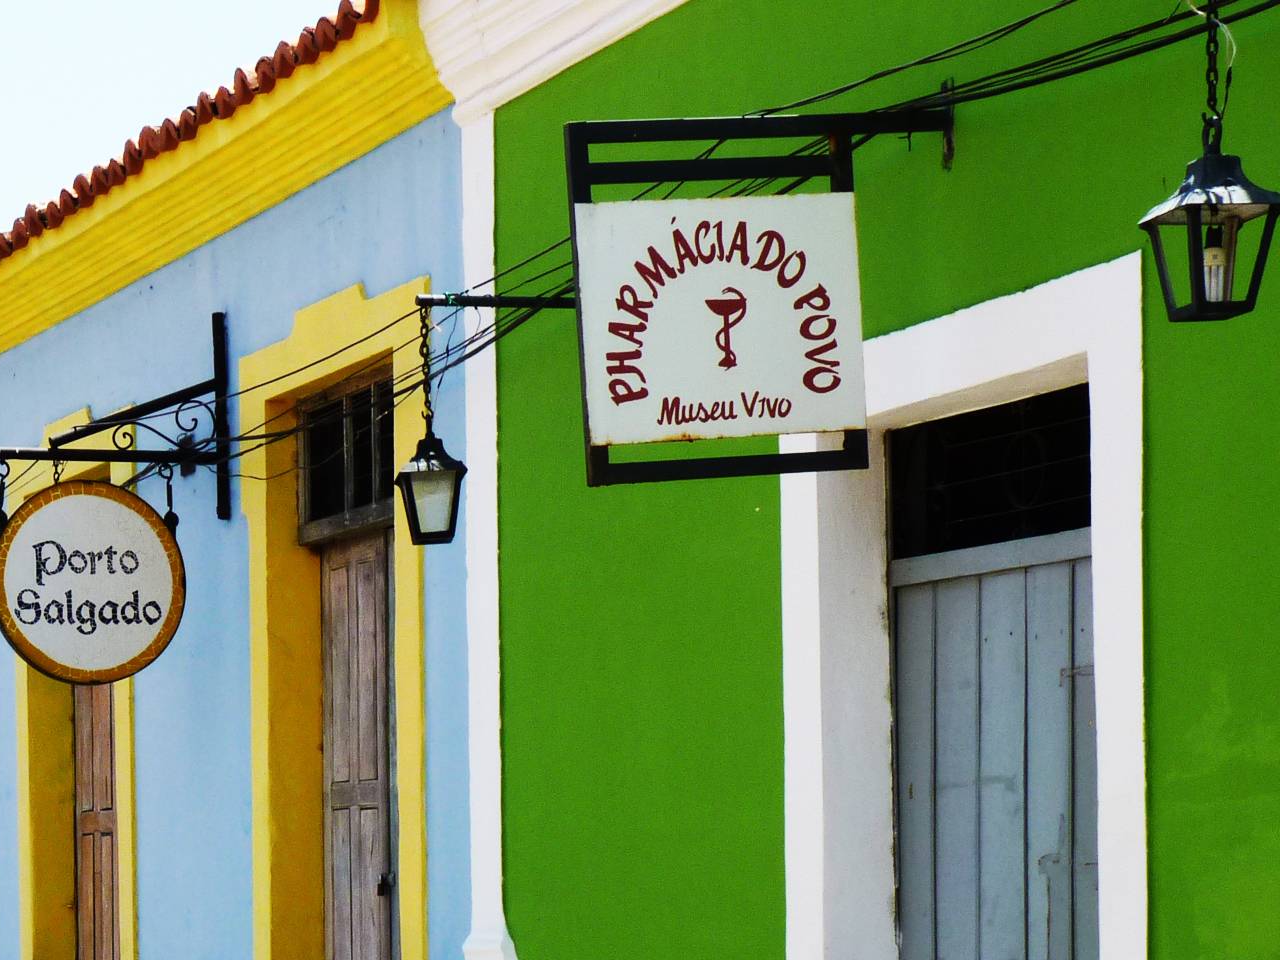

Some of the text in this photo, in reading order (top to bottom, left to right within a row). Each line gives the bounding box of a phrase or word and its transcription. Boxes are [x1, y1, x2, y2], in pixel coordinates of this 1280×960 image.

[606, 217, 841, 406] PHARMÁCIA DO POVO
[657, 397, 737, 425] Museu
[32, 540, 140, 586] Porto
[14, 588, 162, 635] Salgado
